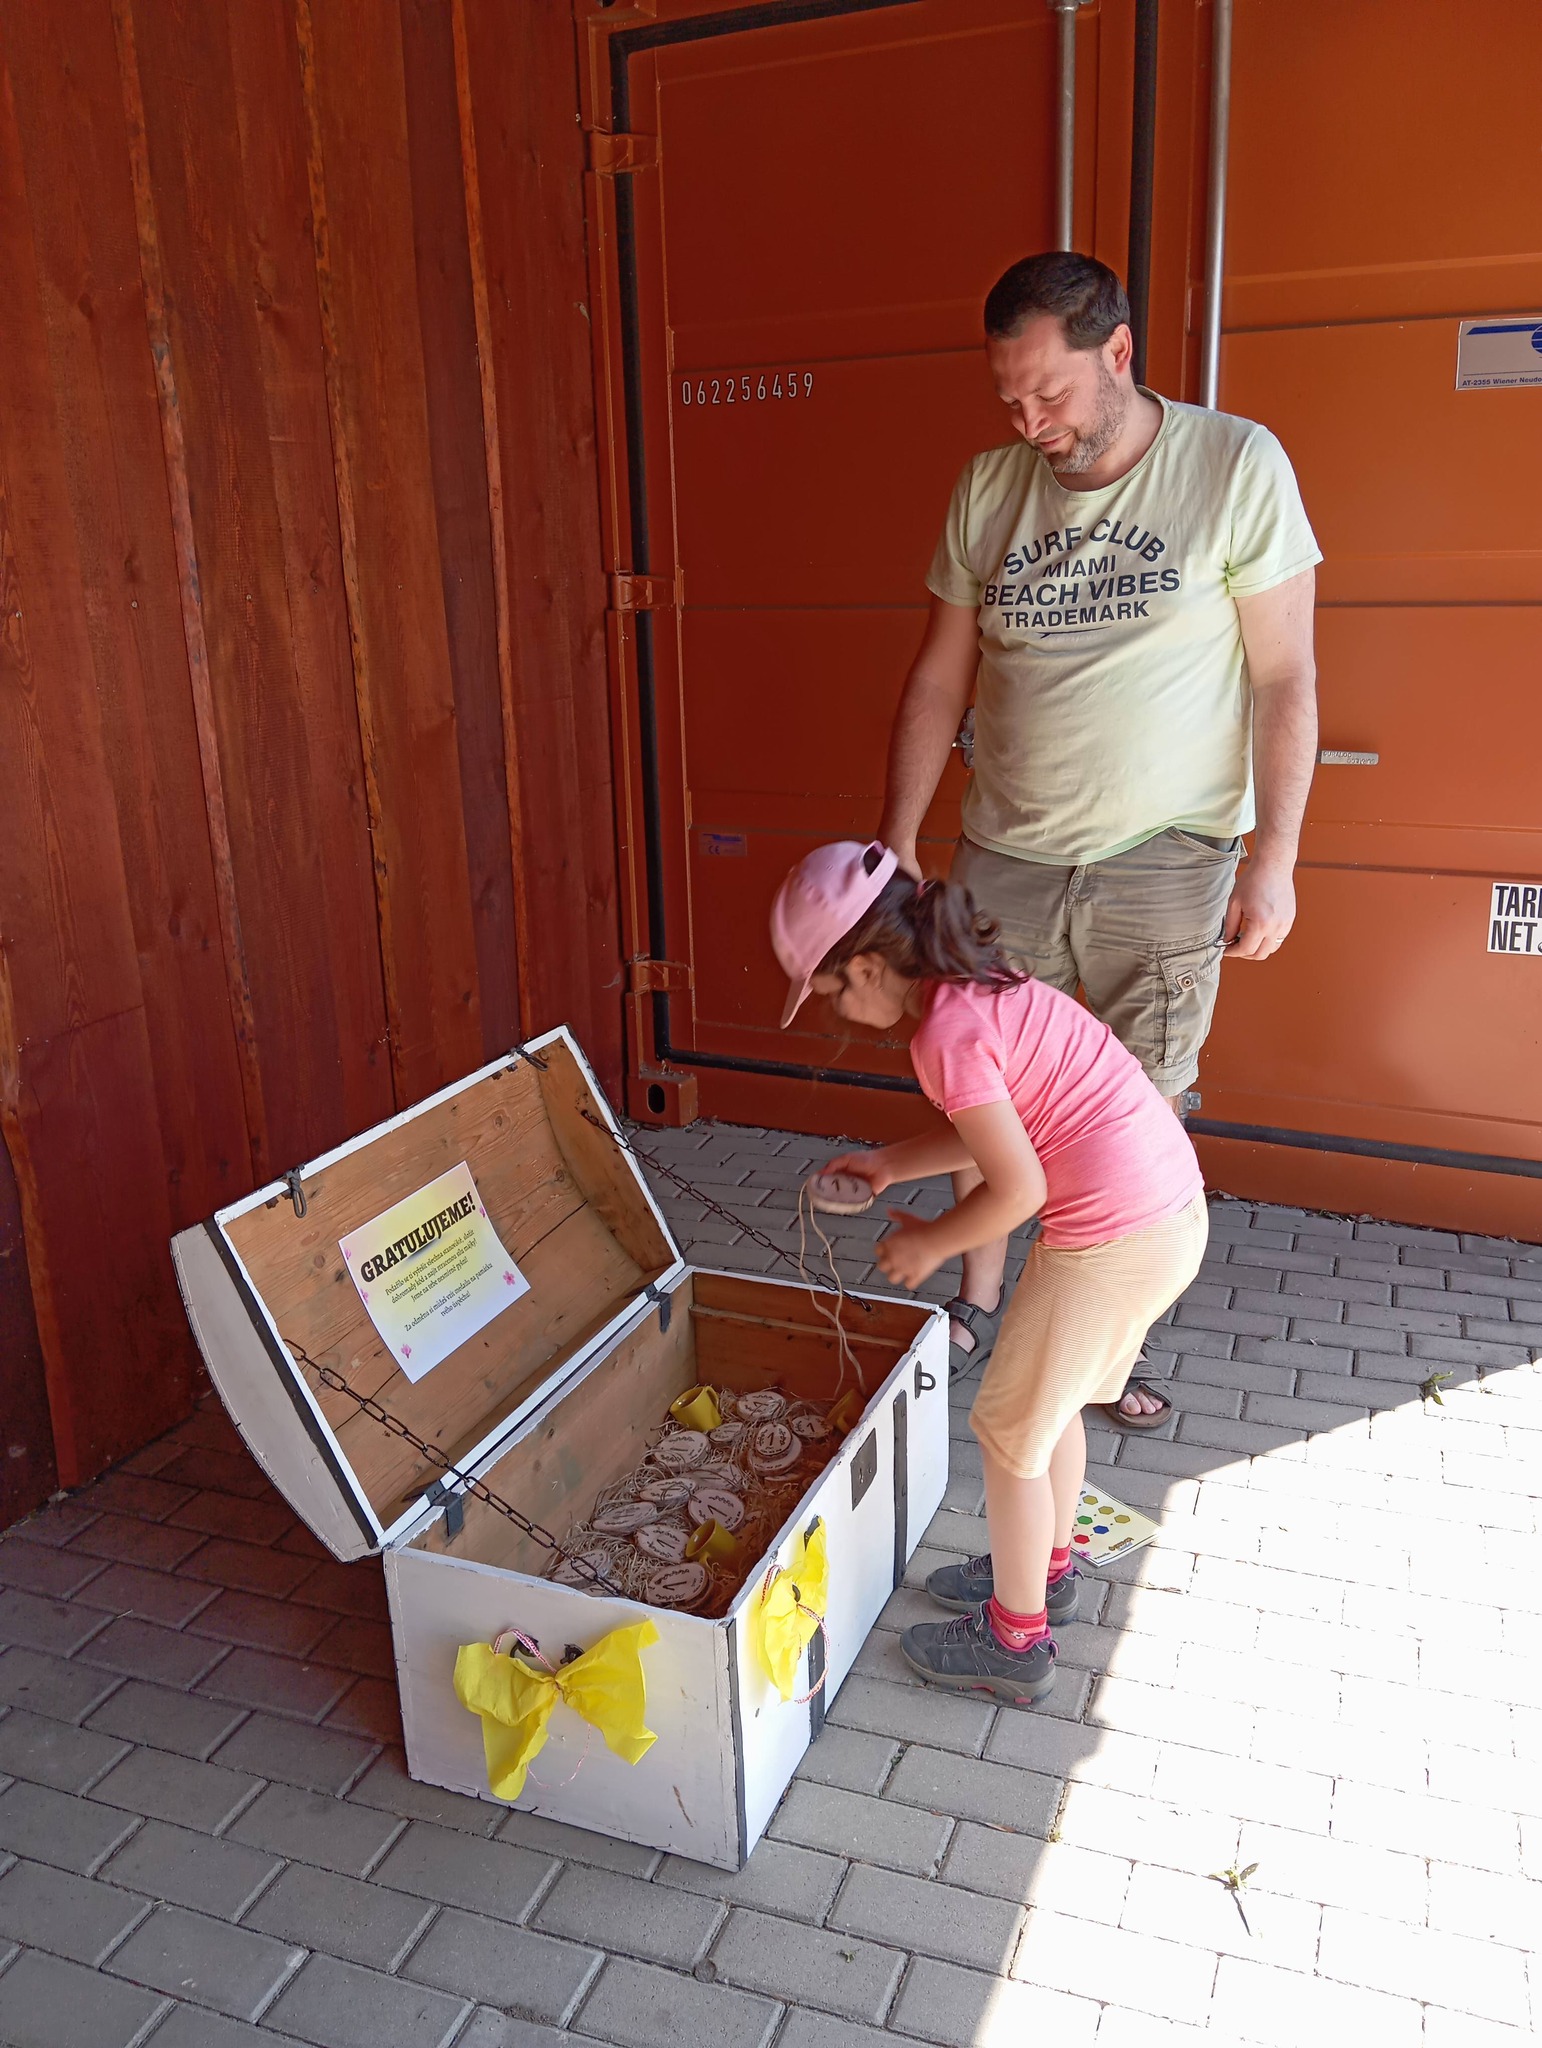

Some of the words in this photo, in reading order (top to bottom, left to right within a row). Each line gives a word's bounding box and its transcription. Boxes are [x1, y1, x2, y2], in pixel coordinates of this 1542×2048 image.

[682, 373, 813, 405] 062256459
[1003, 527, 1082, 575] SURF
[1090, 519, 1165, 562] CLUB
[1042, 555, 1116, 578] MIAMI
[985, 583, 1079, 606] BEACH
[1089, 568, 1180, 600] VIBES
[1002, 600, 1150, 629] TRADEMARK
[1491, 920, 1538, 952] NET
[360, 1191, 476, 1282] GRATULUJEME!
